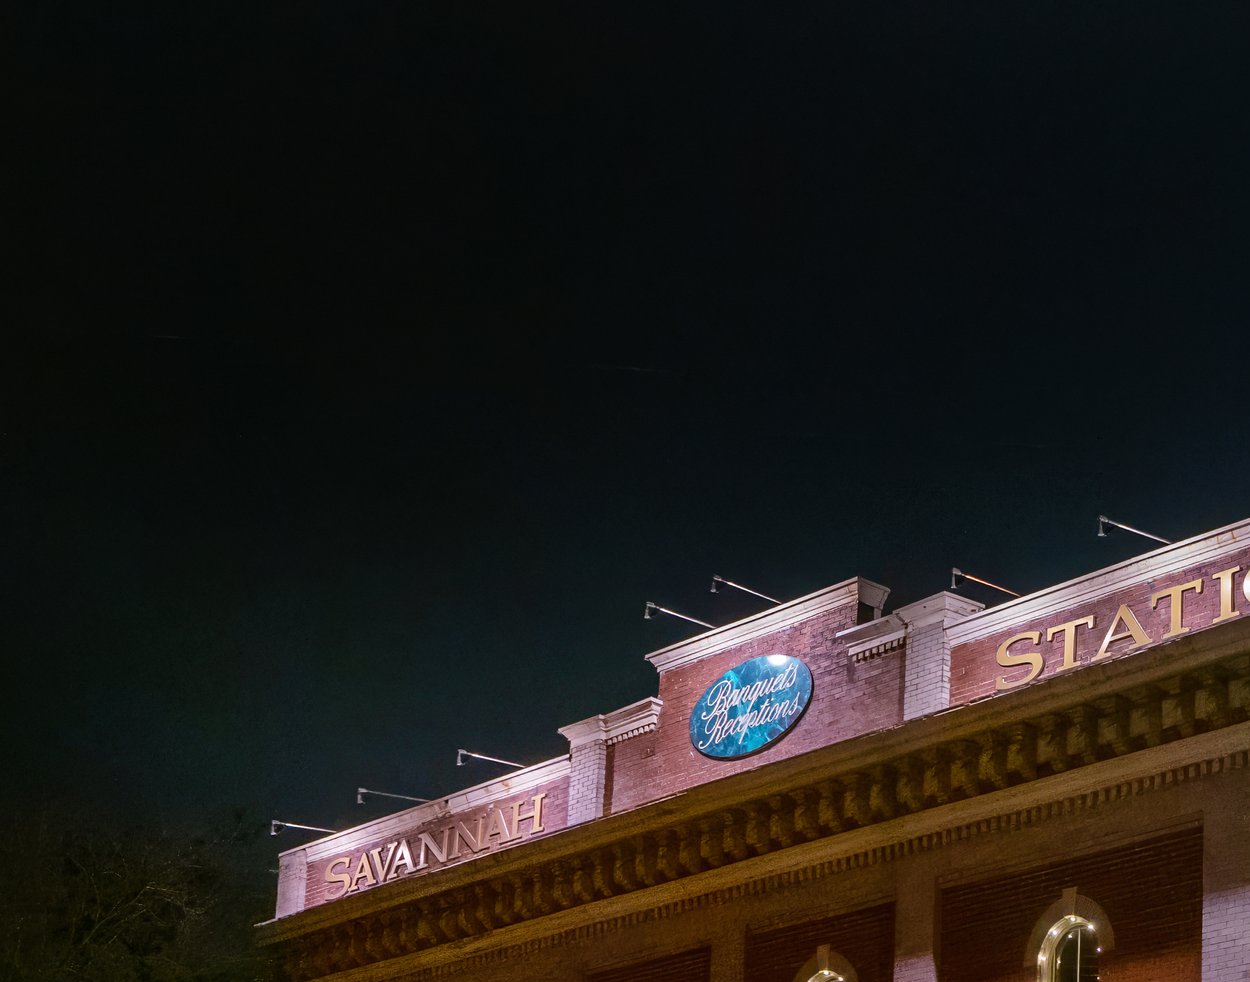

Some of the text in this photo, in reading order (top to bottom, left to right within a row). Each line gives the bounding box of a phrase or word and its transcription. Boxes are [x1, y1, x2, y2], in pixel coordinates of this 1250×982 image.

[701, 663, 798, 720] Banquets
[698, 692, 800, 749] Receptions
[324, 793, 547, 901] SAVANNAH
